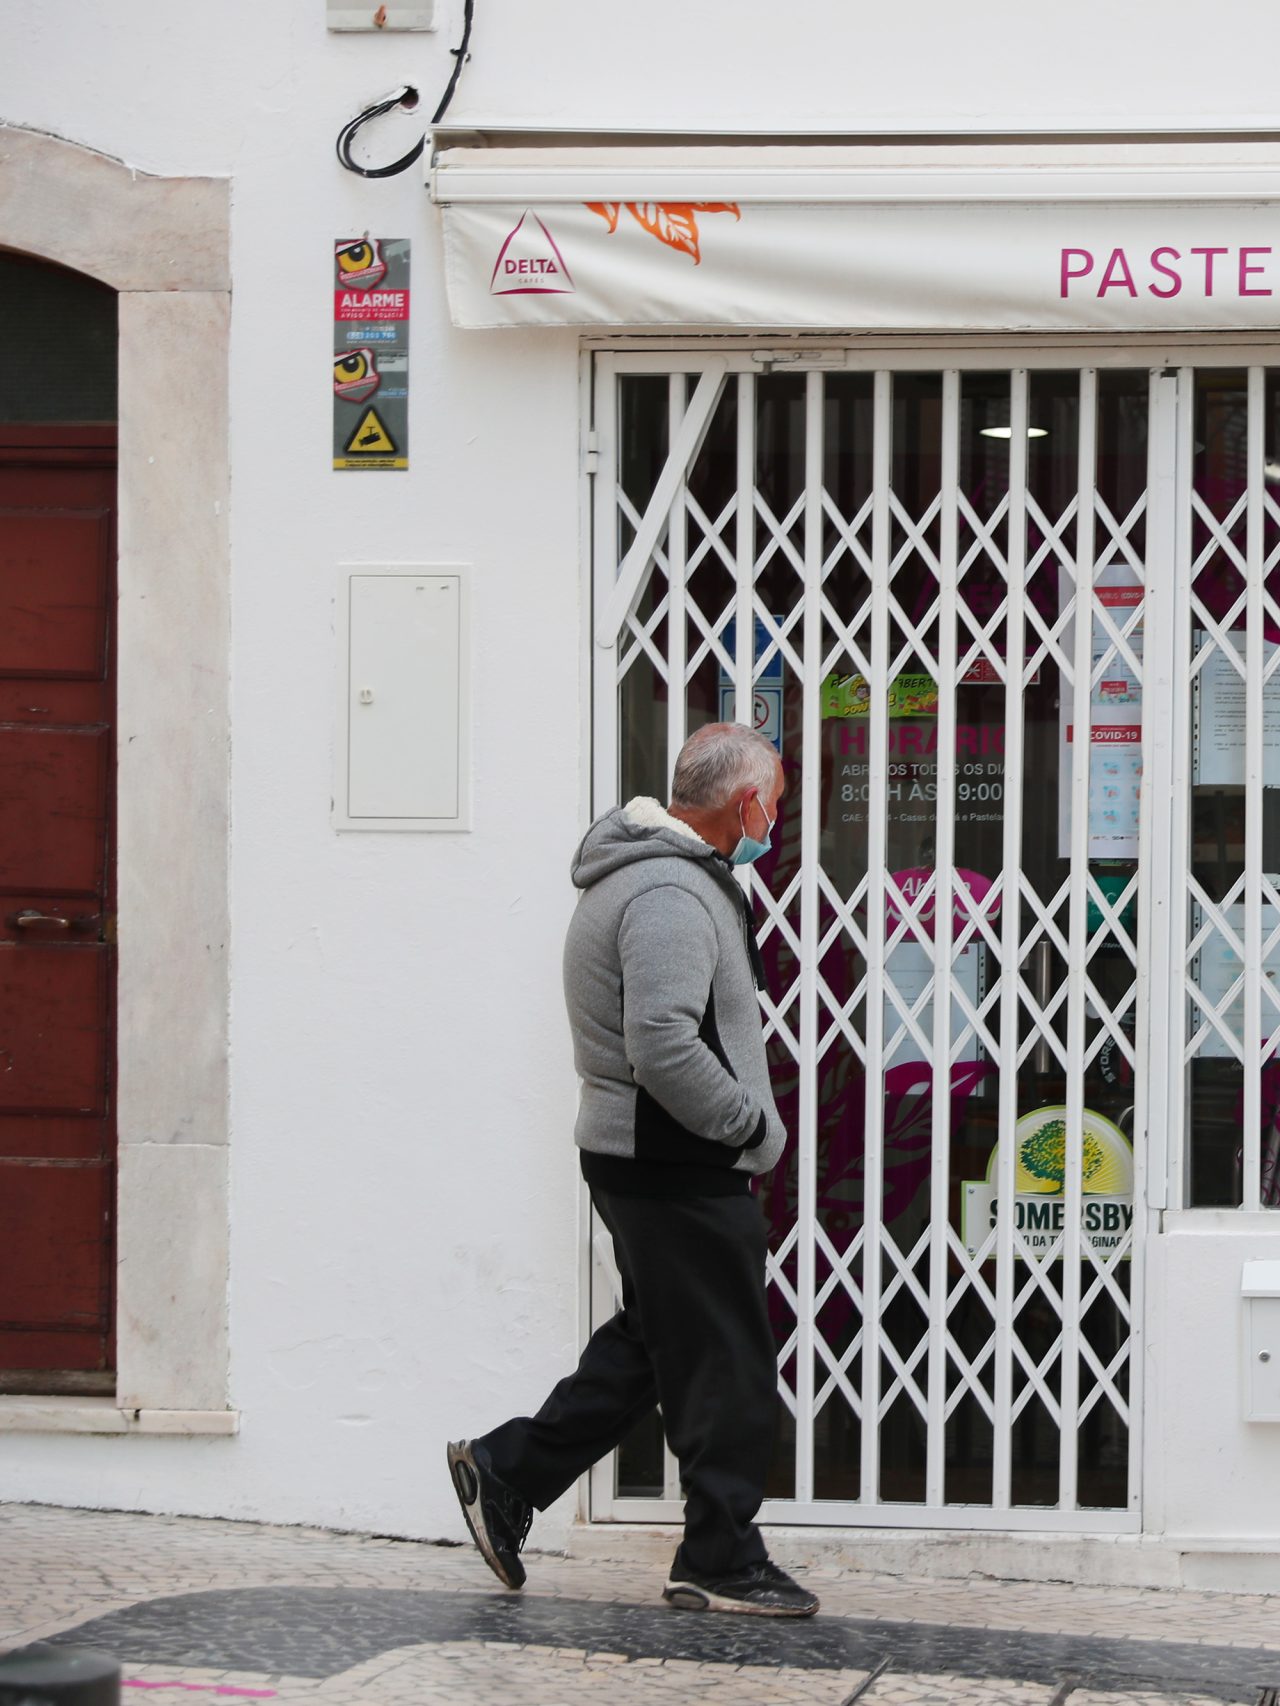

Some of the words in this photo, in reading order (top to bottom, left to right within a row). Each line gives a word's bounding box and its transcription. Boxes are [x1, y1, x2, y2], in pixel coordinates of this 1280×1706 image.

[504, 258, 558, 274] DELTA
[341, 293, 405, 307] ALARME
[840, 725, 1006, 755] HRRI
[841, 764, 907, 776] ABROS
[911, 764, 959, 776] TODS
[963, 764, 984, 775] OS
[841, 784, 901, 801] 8:0H
[989, 1198, 1134, 1231] SOMESBY
